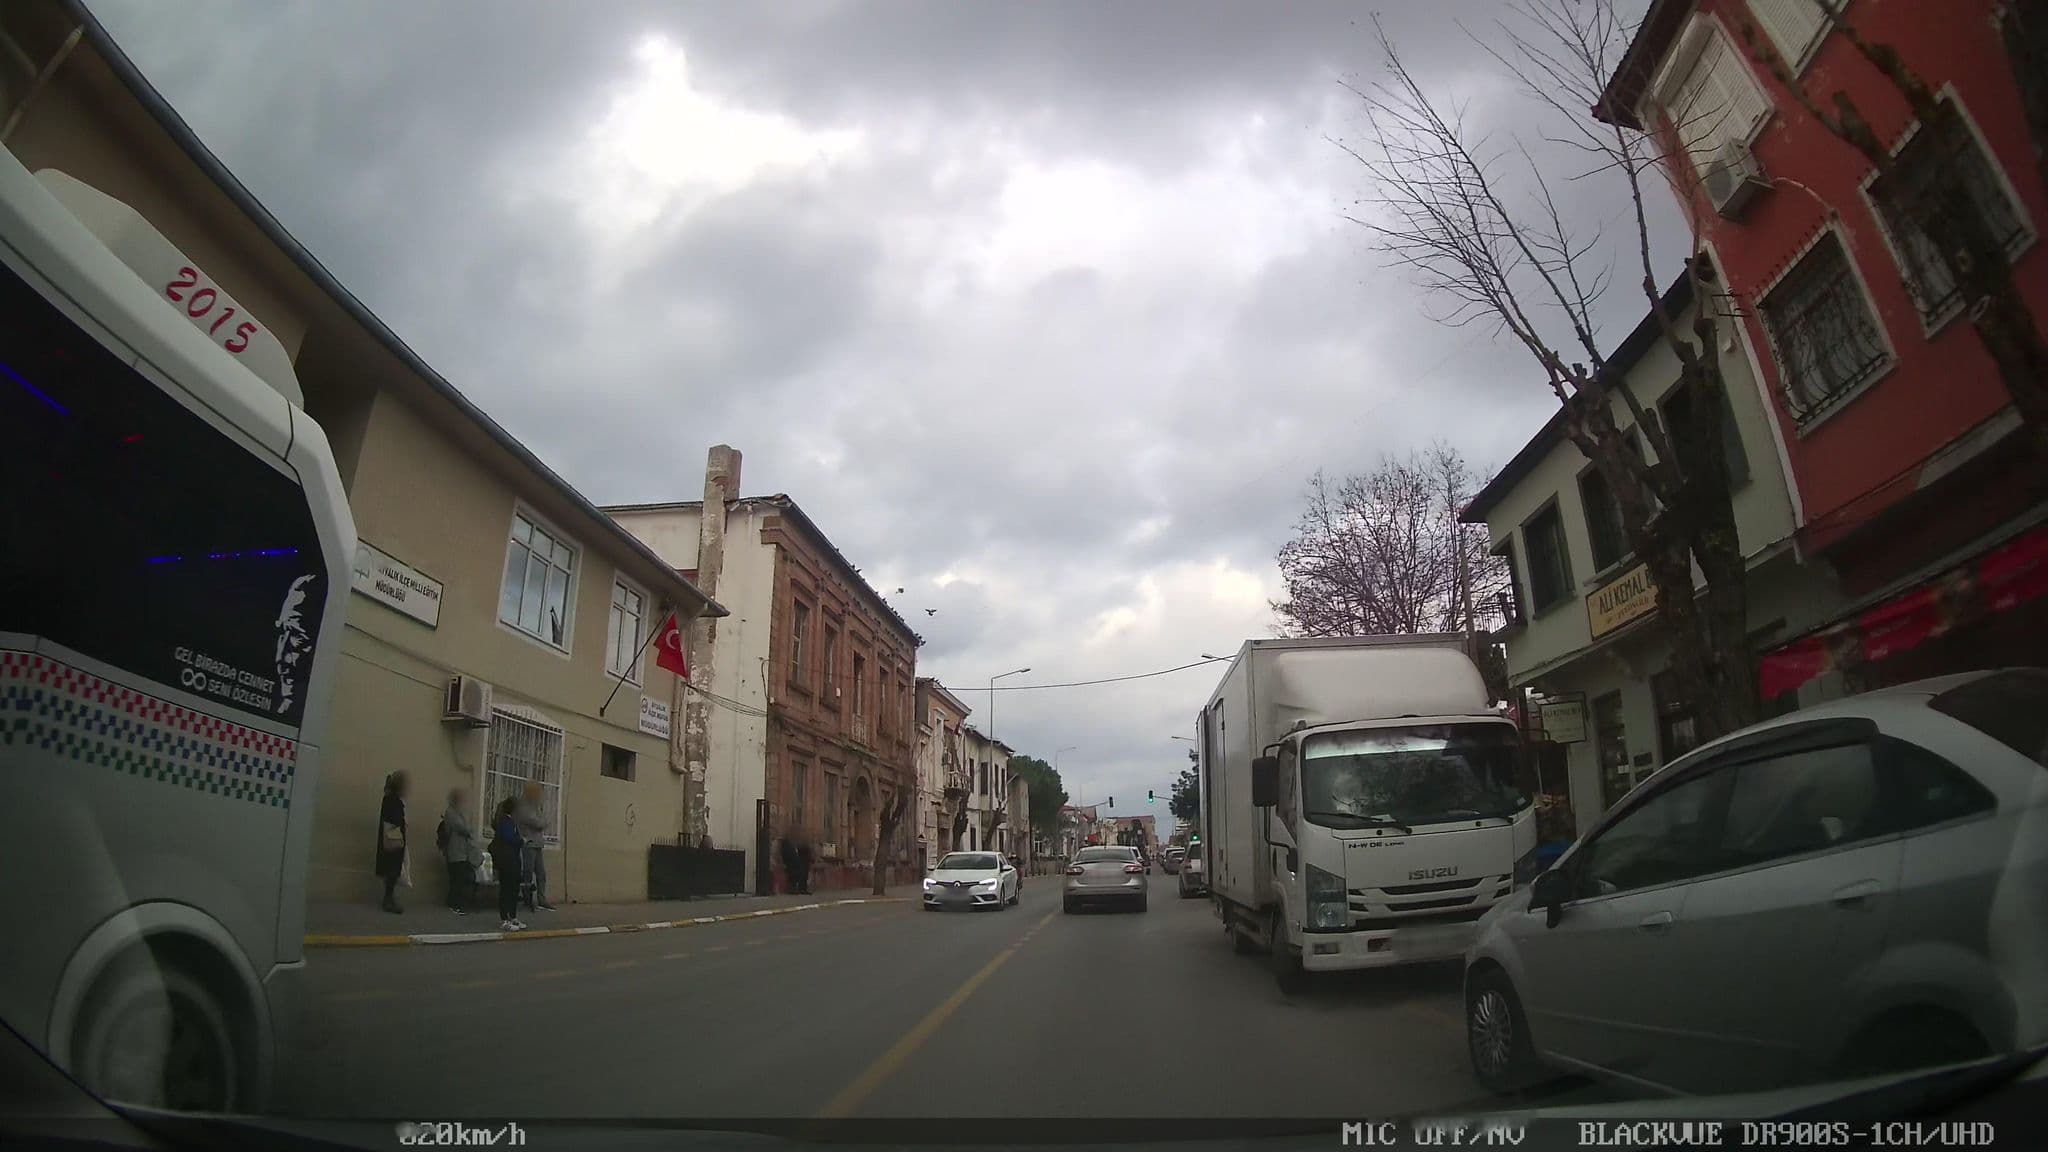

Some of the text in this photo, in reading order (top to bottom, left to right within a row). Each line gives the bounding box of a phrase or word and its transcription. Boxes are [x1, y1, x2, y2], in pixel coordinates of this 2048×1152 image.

[166, 266, 257, 353] 2015
[238, 670, 275, 693] CENNET
[1408, 866, 1458, 881] ISUZU
